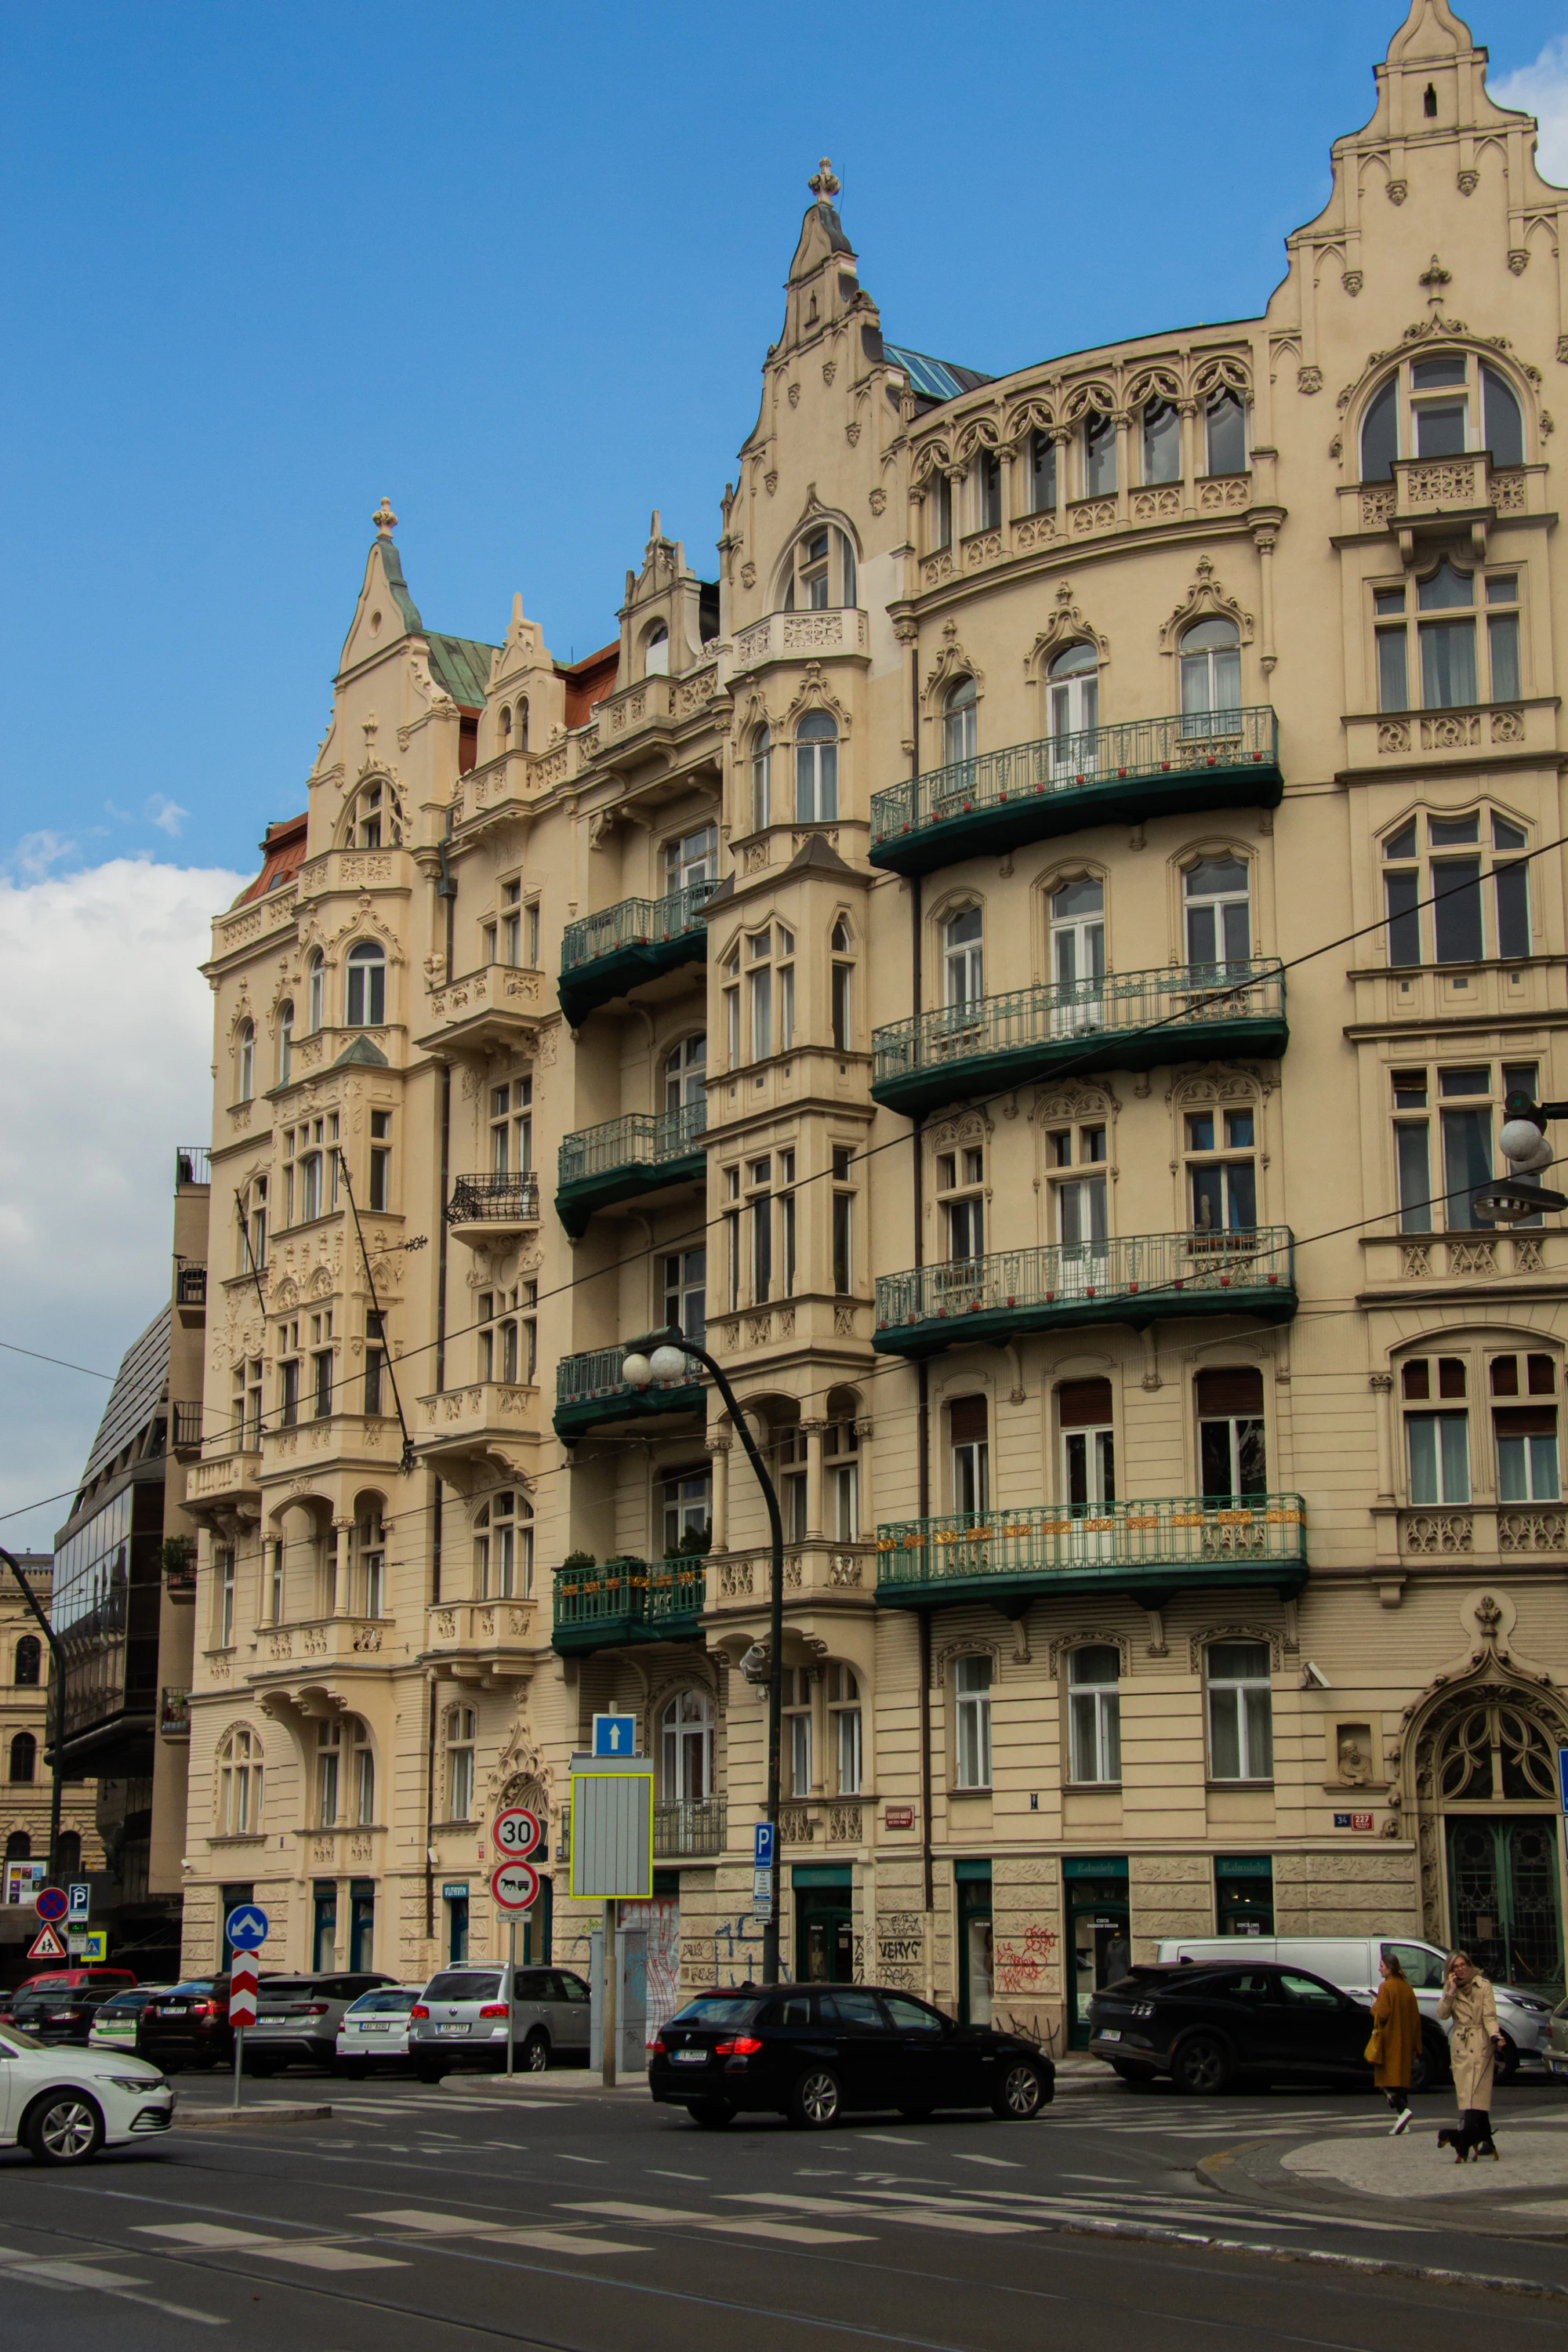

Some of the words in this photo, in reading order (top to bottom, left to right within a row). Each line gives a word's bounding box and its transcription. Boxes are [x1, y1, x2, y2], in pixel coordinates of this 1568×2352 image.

[503, 1820, 531, 1843] 30
[758, 1828, 769, 1853] P
[73, 1892, 86, 1908] P
